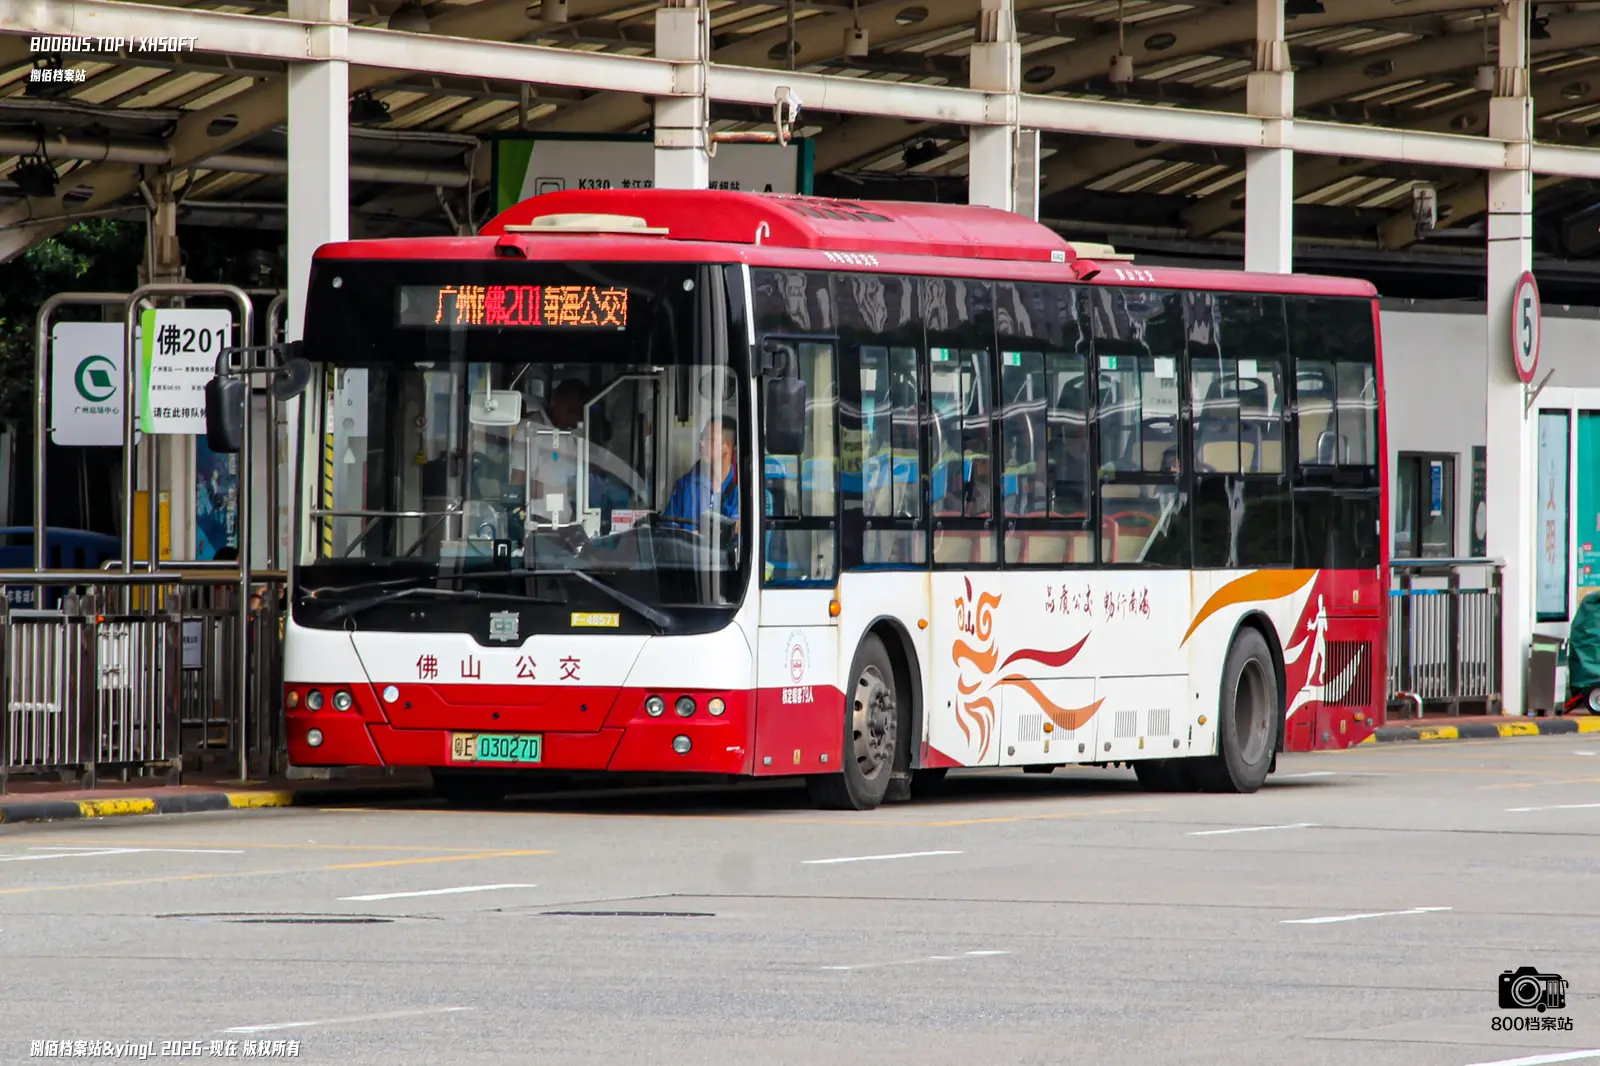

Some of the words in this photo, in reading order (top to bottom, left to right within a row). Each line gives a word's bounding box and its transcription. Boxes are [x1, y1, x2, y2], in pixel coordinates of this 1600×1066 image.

[578, 178, 610, 190] K330
[157, 325, 226, 356] 佛201
[1523, 298, 1532, 357] 5
[416, 654, 582, 681] 佛山公交
[481, 737, 538, 759] 03027D
